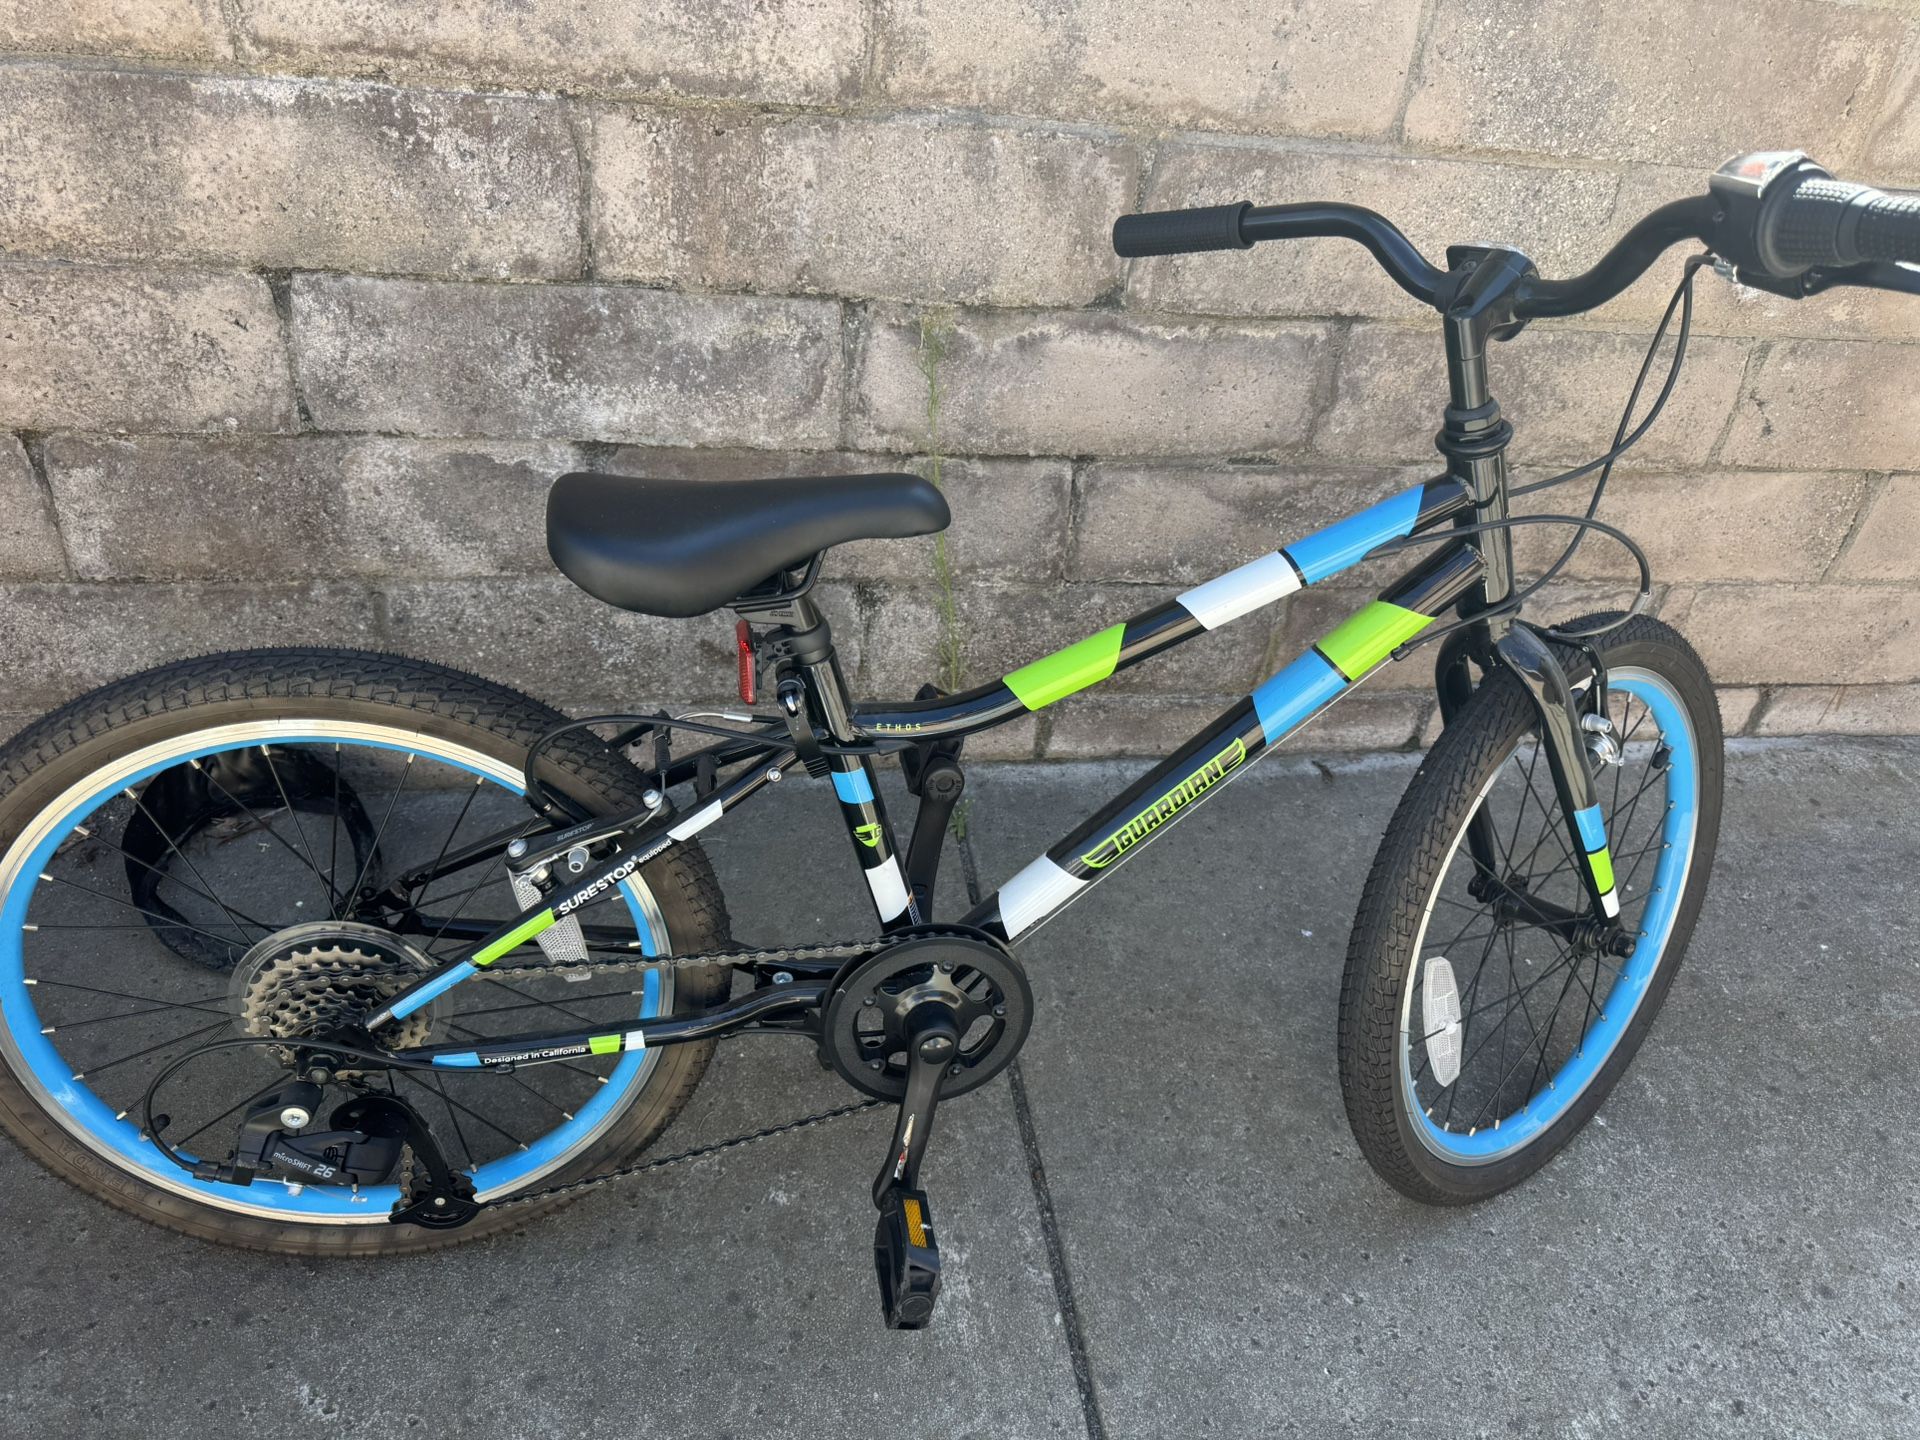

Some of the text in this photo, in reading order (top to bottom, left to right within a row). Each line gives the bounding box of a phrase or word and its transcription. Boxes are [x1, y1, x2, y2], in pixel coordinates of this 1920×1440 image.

[876, 723, 921, 731] ETHOS
[1115, 760, 1222, 851] GUARDIAN
[638, 839, 673, 863] equipped
[484, 1046, 586, 1065] Designed in California
[273, 1152, 336, 1178] microSHIFT 26
